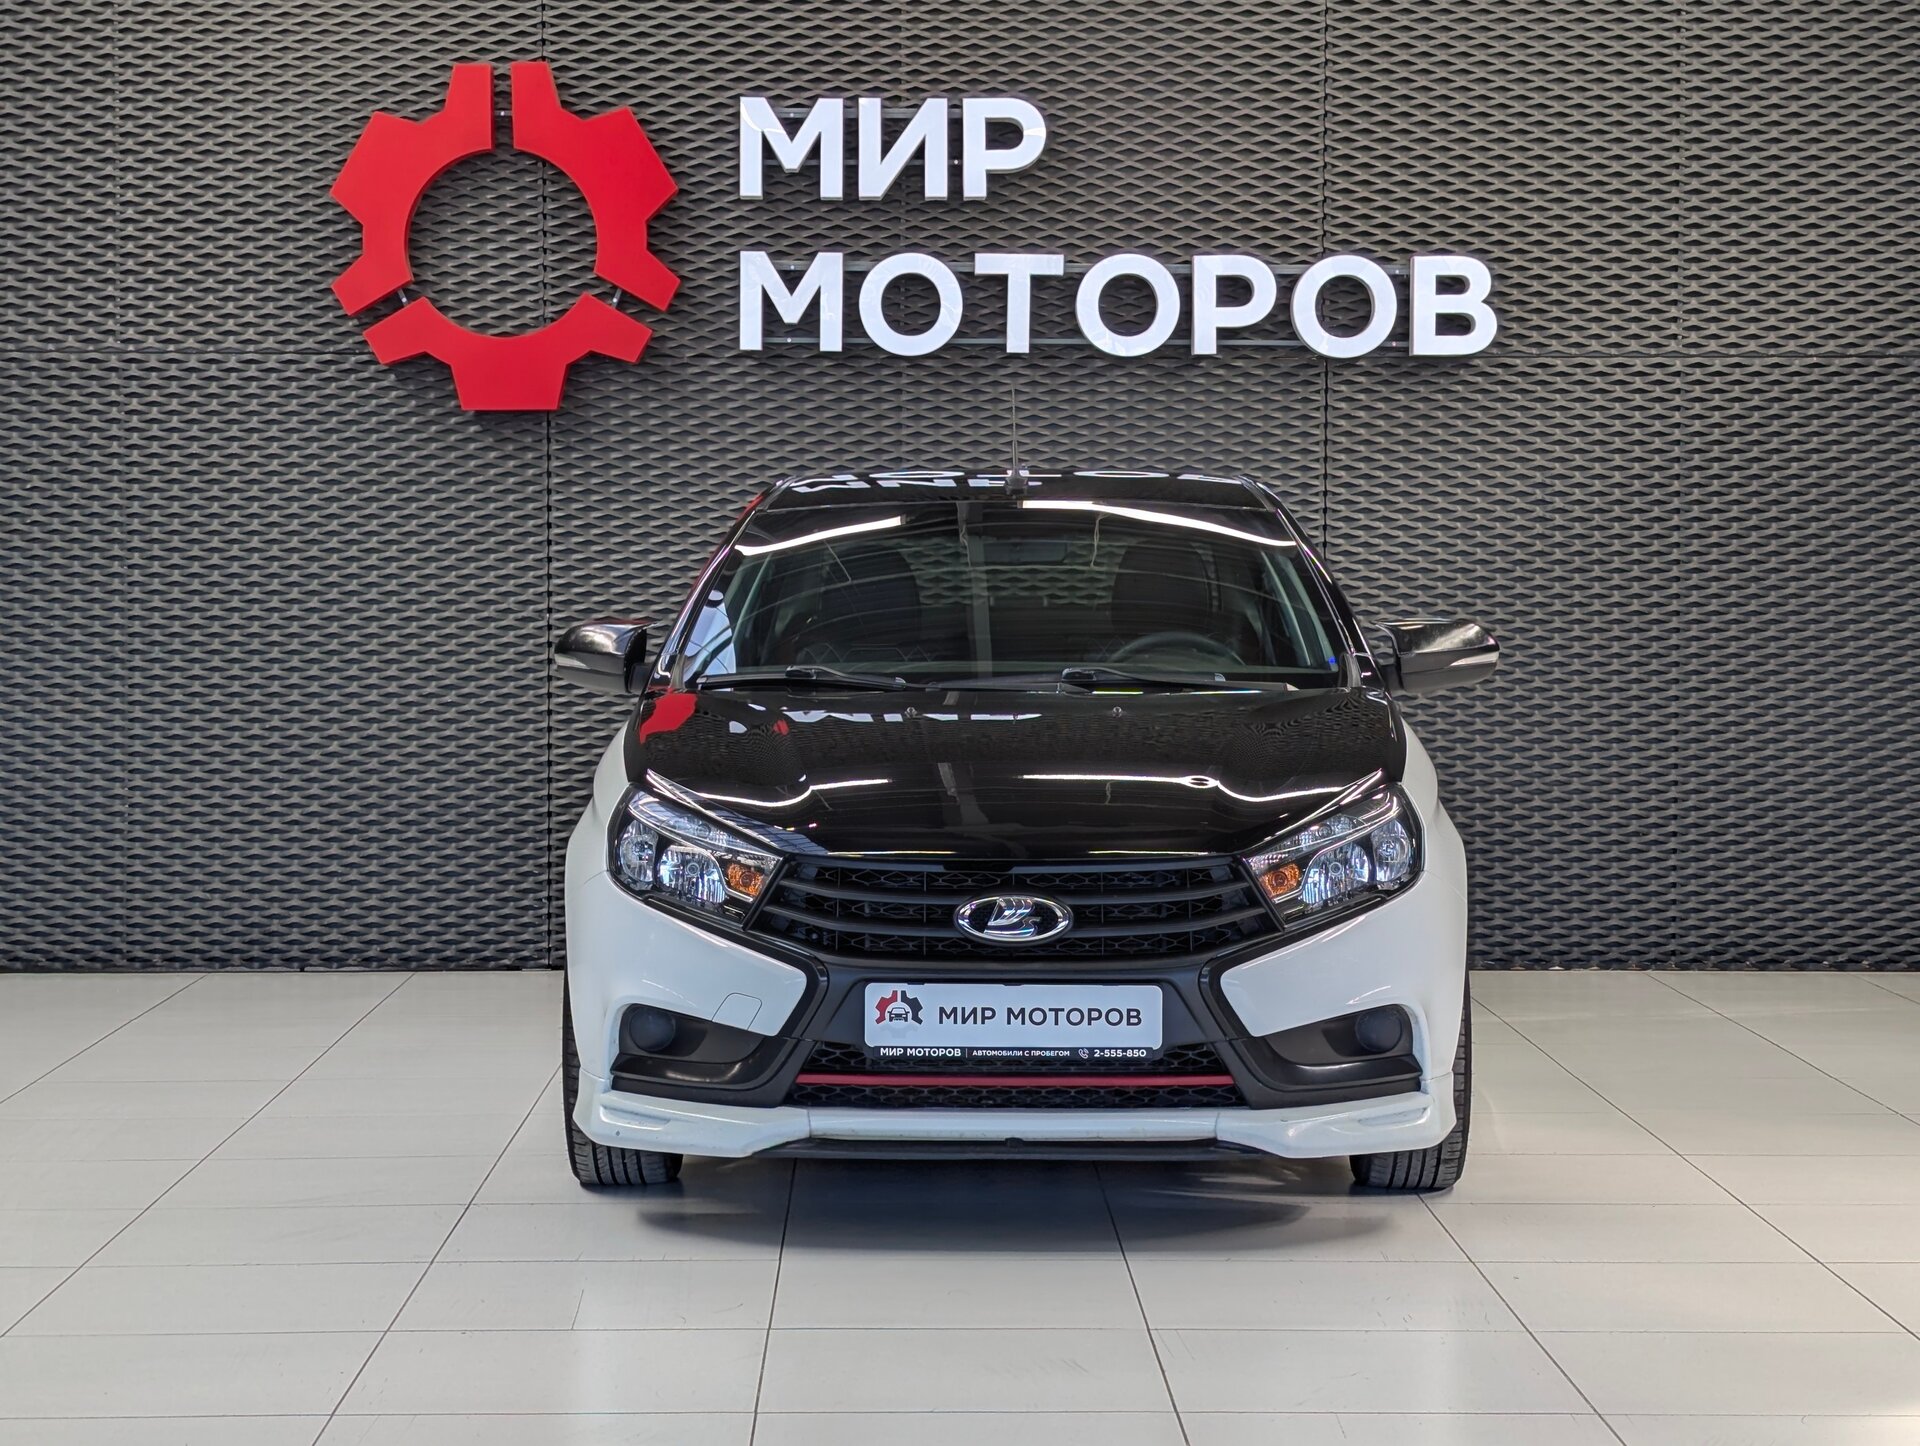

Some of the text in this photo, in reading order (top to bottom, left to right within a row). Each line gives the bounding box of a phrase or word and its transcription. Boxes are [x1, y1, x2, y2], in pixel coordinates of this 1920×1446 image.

[740, 97, 1046, 199] МИР
[739, 251, 1498, 358] МОТОРОВ
[938, 1006, 1142, 1026] МИР МОТОРОВ
[880, 1048, 904, 1056] МИР
[907, 1048, 961, 1057] МОТОРОВ
[1093, 1049, 1147, 1058] 2-555-850
